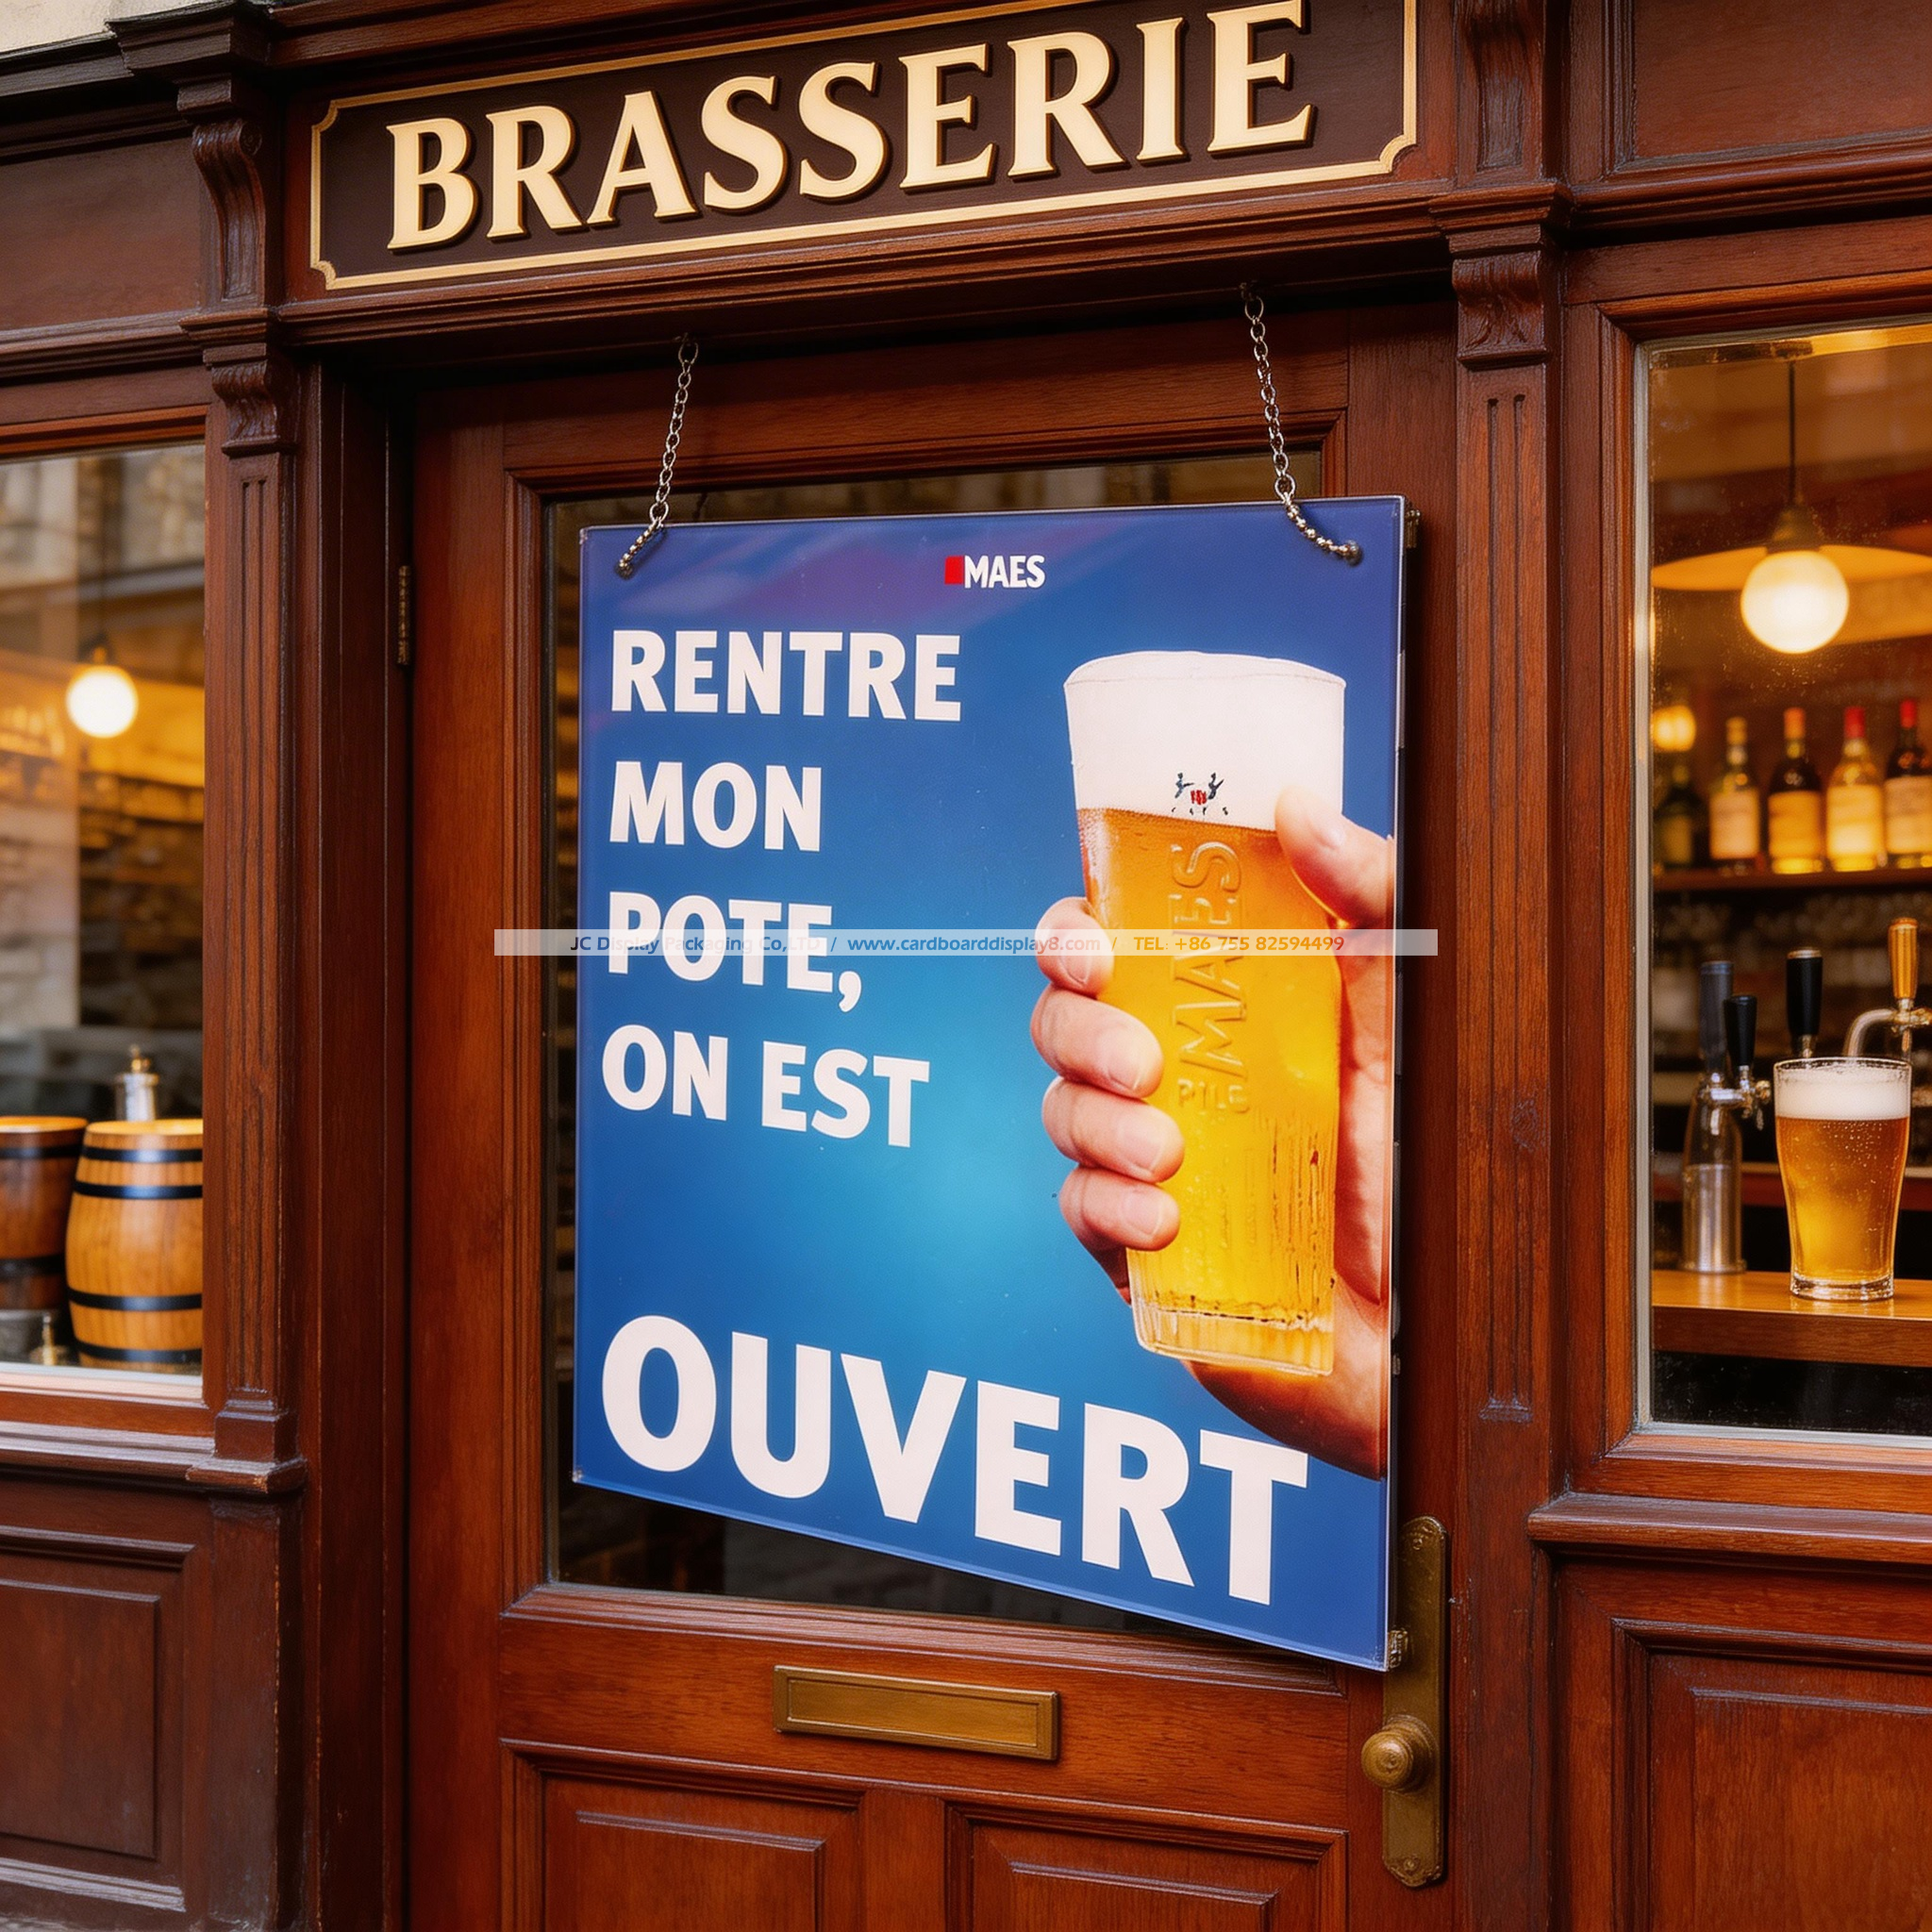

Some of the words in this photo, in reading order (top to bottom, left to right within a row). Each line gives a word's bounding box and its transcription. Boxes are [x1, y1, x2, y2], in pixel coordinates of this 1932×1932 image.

[386, 0, 1312, 252] BRASSERIE
[964, 555, 1046, 589] MAES
[611, 629, 961, 722] RENTRE
[609, 760, 822, 852] MON
[608, 891, 861, 1012] POTE,
[1170, 840, 1248, 1079] MAES
[602, 1024, 728, 1121] ON
[761, 1041, 930, 1148] EST
[602, 1315, 1308, 1606] OUVERT
